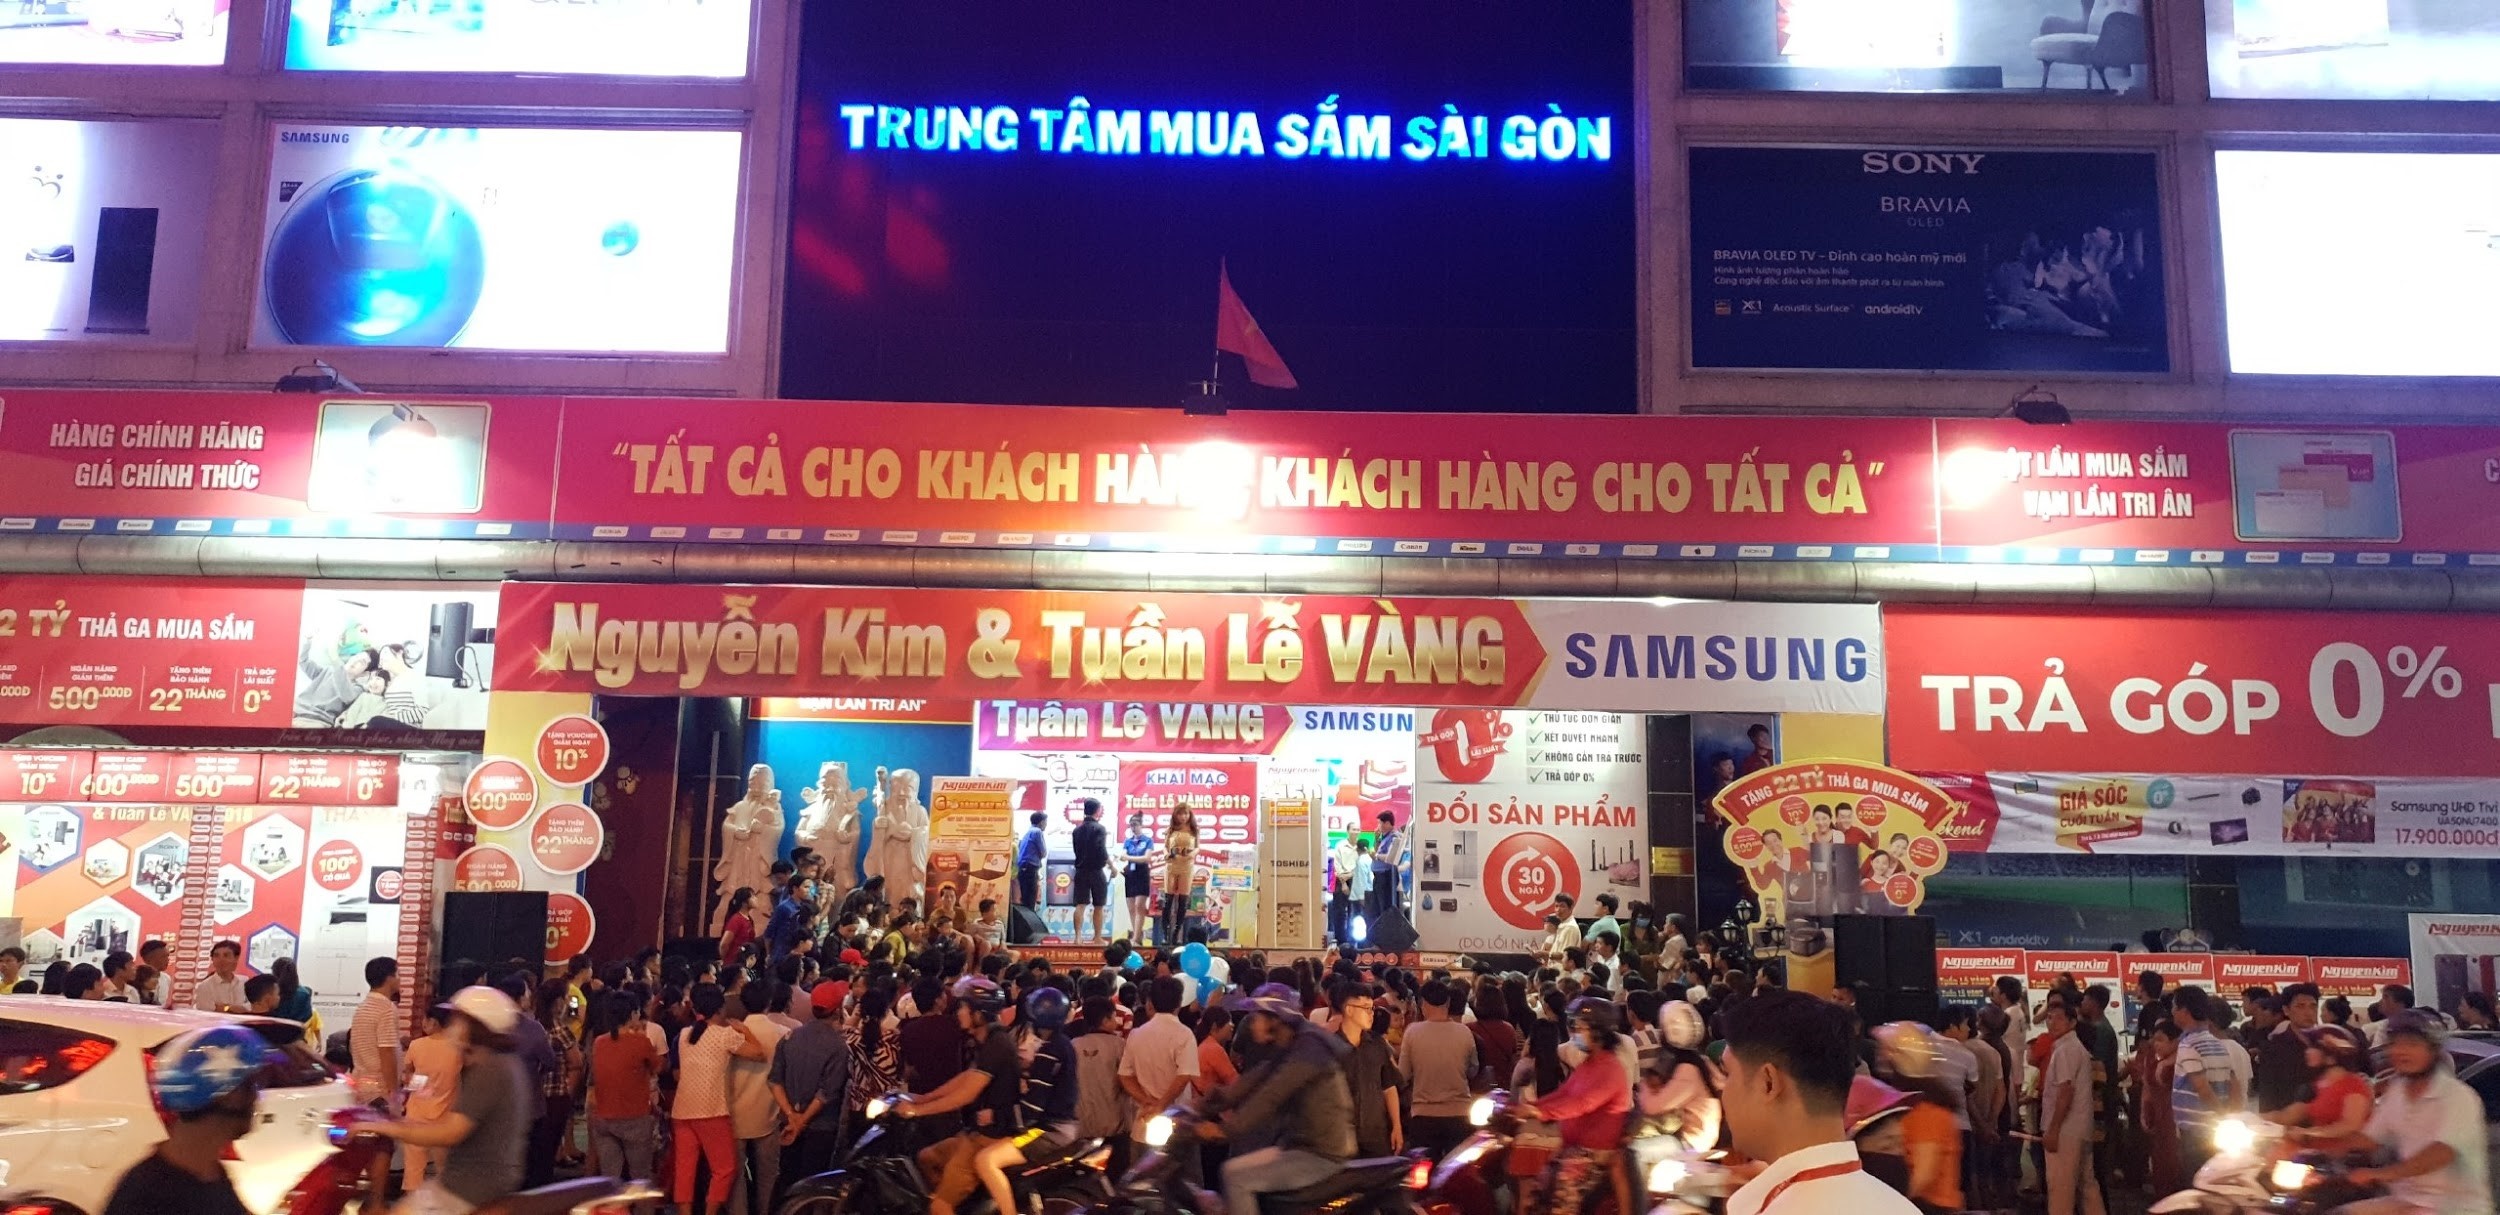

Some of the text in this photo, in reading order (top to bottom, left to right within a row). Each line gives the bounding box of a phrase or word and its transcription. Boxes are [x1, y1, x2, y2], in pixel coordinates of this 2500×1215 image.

[839, 95, 1612, 162] TRUNG TÂM MUA SẮM SÀI GÒN
[281, 131, 350, 144] SAMSUNG
[1862, 152, 1985, 174] SONY
[1881, 197, 1971, 214] BRAVIA
[1907, 217, 1944, 228] OLED
[1714, 250, 1967, 265] BRAVIA OLED TV Đỉnh cao hoàn mỹ mới
[1773, 303, 1924, 315] Acoustic Surface androidtv
[50, 419, 265, 450] HÀNG CHÍNH HÃNG
[2036, 444, 2189, 478] LẦN MUA SẮM
[74, 458, 262, 489] GIÁ CHÍNH THỨC
[726, 433, 787, 497] CẢ
[801, 445, 902, 499] CHO
[916, 441, 1080, 504] KHÁCH
[1260, 446, 1422, 510] KHÁCH
[1438, 449, 1578, 513] HÀNG
[1592, 461, 1693, 515] CHO
[1705, 445, 1790, 514] TẤT
[2023, 483, 2193, 522] VẠN LẦN TRI ÂN
[29, 600, 255, 641] TỶ THẢ GA MUA SẮM
[548, 594, 1506, 689] Nguyễn Kim & Tuần Lễ VÀNG
[1564, 632, 1868, 683] SAMSUNG
[1921, 641, 2463, 738] TRẢ GÓP 0%
[149, 686, 227, 712] 22 THÁNG
[243, 688, 272, 713] 0%
[869, 699, 895, 711] TRI
[1305, 710, 1414, 732] SAMSUN
[566, 732, 598, 740] VOUCHER
[1590, 734, 1619, 744] NHANH
[554, 748, 589, 771] 10%
[1545, 750, 1574, 763] KHÔNG
[1146, 772, 1229, 788] KHAI MẠC
[1563, 770, 1581, 782] GÓP
[1583, 771, 1595, 782] 0%
[269, 776, 300, 799] 22
[357, 776, 384, 801] 0%
[1740, 785, 1774, 808] TẶNG
[1773, 774, 1800, 794] 22
[1800, 765, 1824, 788] TỶ
[1827, 772, 1851, 788] THẢ
[1852, 774, 1870, 791] GA
[1871, 780, 1900, 800] MUA
[1900, 788, 1930, 814] SẮM
[2060, 785, 2088, 812] GIÁ
[2094, 779, 2129, 808] SỐC
[1216, 795, 1250, 809] 2018
[1427, 790, 1637, 827] ĐỔI SẢN PHẨM
[2390, 800, 2499, 815] Samsung UHD Tivi
[92, 806, 105, 822] &
[562, 835, 595, 846] THÁNG
[2395, 828, 2499, 846] 17.900.000đ
[319, 856, 358, 872] 100%
[1270, 859, 1310, 868] TOSHIBA
[1518, 867, 1545, 885] 30
[545, 925, 570, 949] 0%
[2428, 922, 2500, 937] NguyenK
[1459, 937, 1485, 950] (DO
[1990, 934, 2050, 946] androidtv
[1942, 955, 2017, 970] NguyenKim
[2035, 958, 2110, 972] NguyenKim
[2128, 960, 2205, 975] NguyenKim
[2222, 962, 2300, 977] NguyenKim
[2321, 964, 2400, 979] NguyenKim
